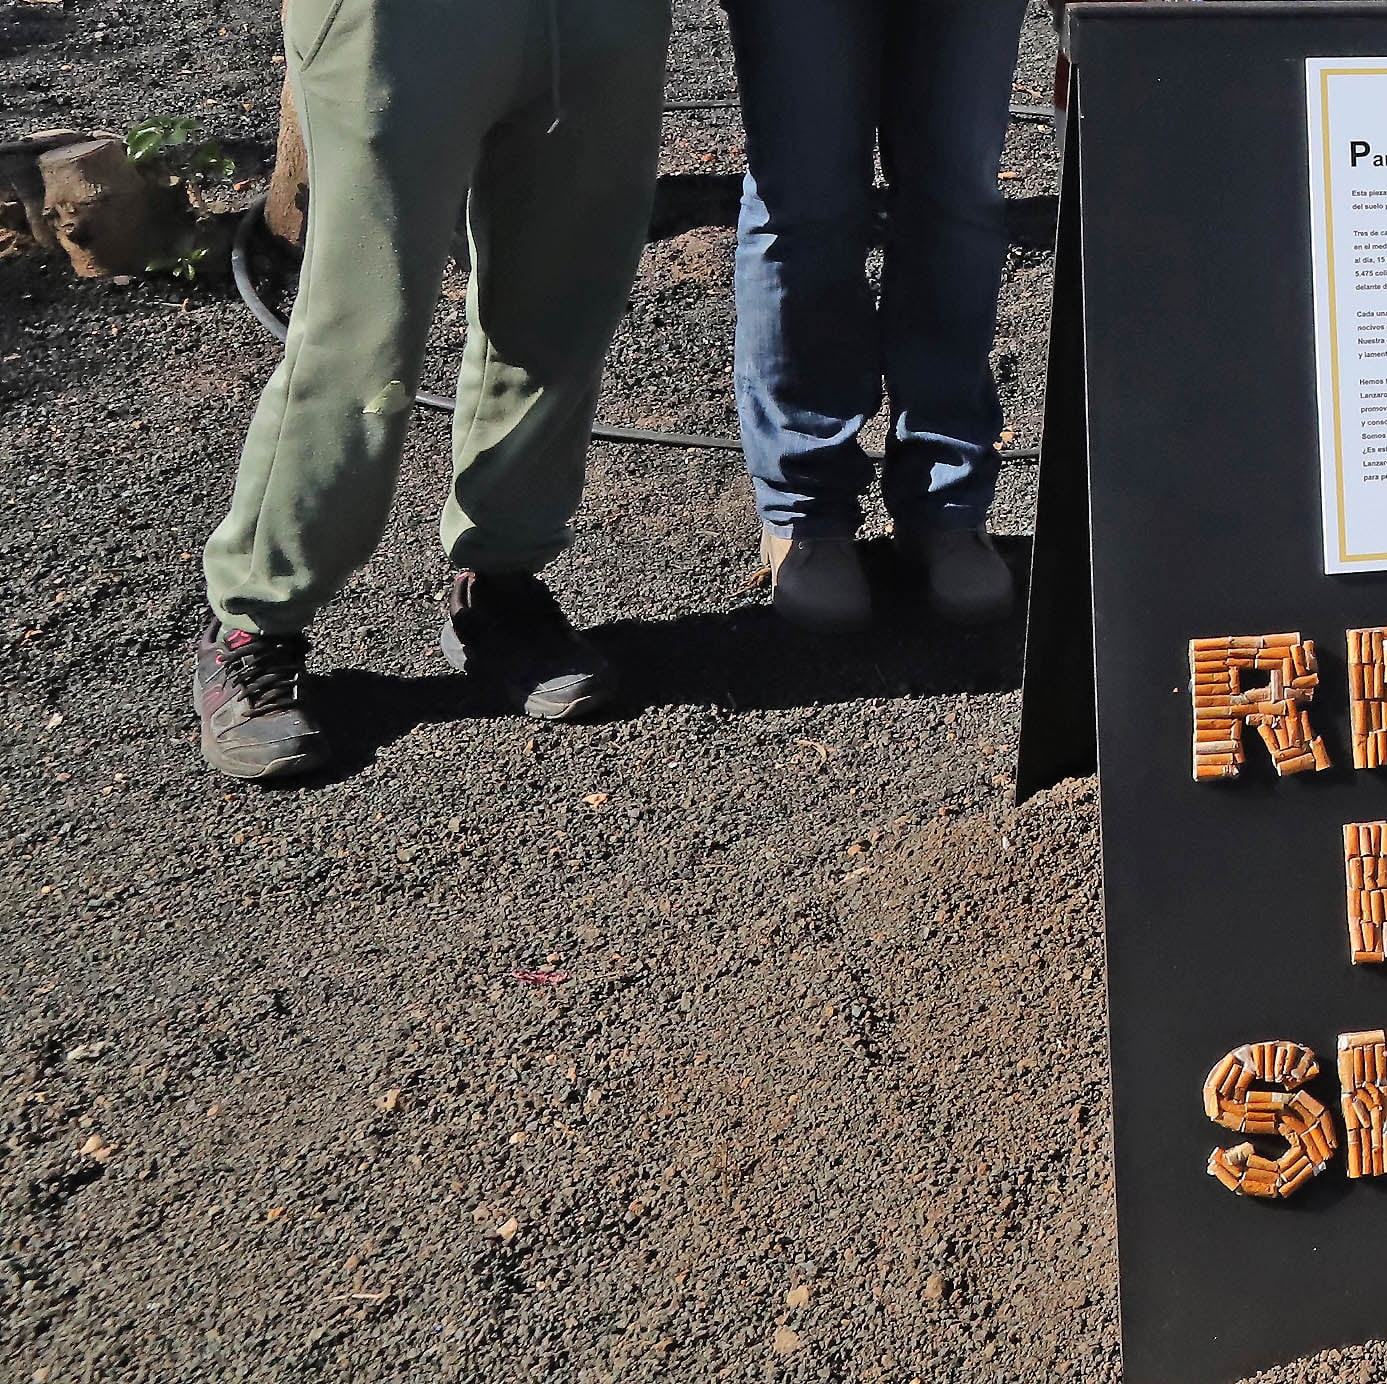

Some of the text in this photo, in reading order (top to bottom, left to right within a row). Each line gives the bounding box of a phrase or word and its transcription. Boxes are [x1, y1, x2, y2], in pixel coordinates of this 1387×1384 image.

[1368, 188, 1387, 198] pieza
[1364, 202, 1383, 210] suelo
[1353, 229, 1368, 237] Tres
[1357, 323, 1384, 331] nocivos
[1362, 431, 1386, 440] Somos
